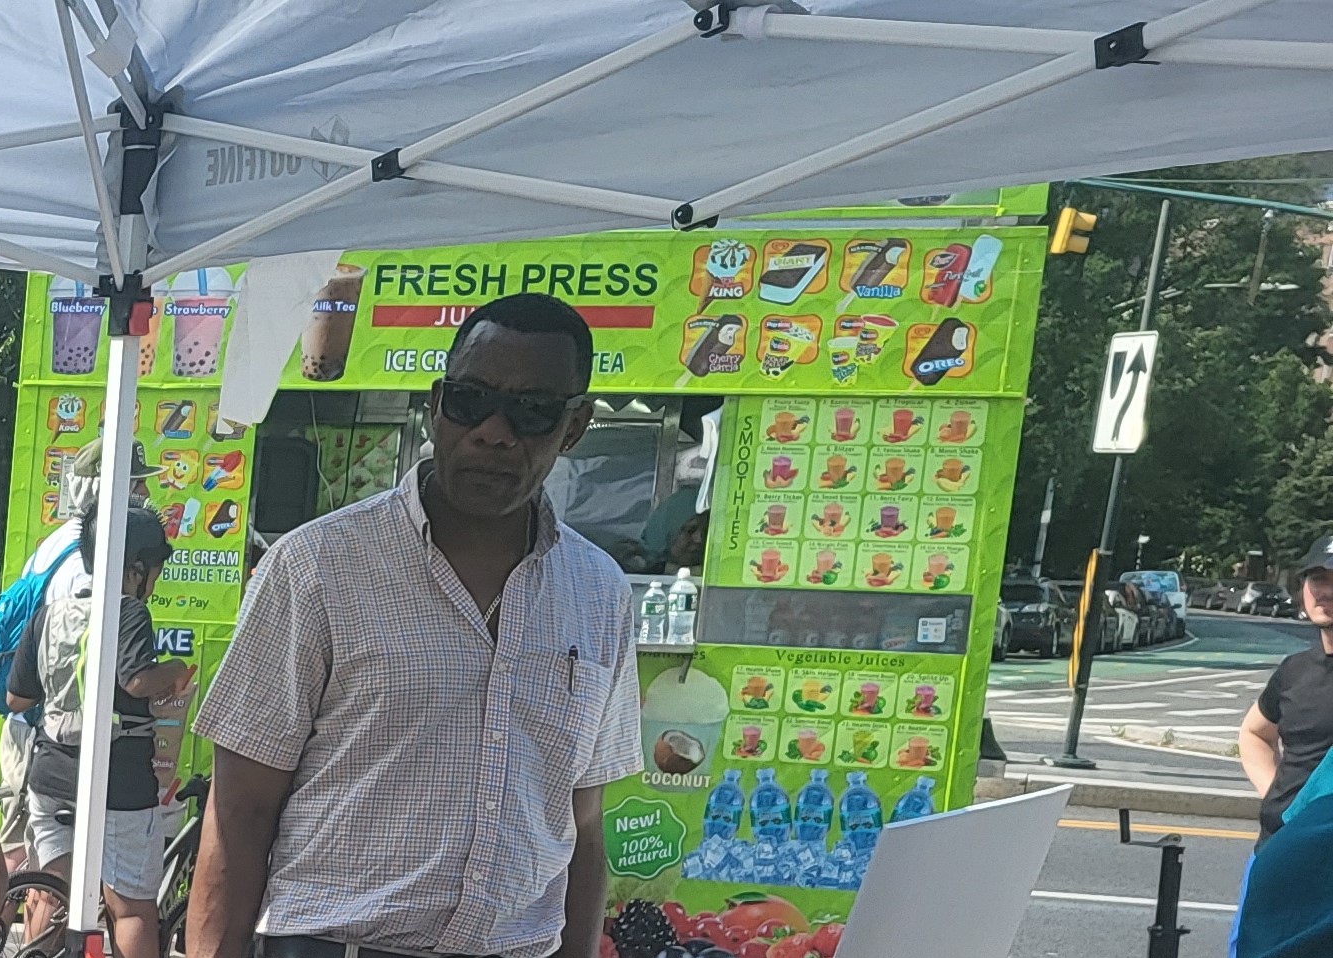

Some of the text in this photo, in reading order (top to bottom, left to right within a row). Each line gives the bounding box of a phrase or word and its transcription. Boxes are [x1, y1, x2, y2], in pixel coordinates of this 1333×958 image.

[374, 263, 659, 296] FRESH PRESS
[709, 287, 743, 297] KING
[856, 286, 902, 298] Vanilla
[51, 302, 106, 316] Blueberry
[165, 304, 231, 317] Strawberry
[335, 301, 355, 312] Tea
[385, 350, 416, 371] ICE
[708, 354, 741, 366] Cherry
[918, 358, 965, 374] OREO
[729, 415, 754, 550] SMOOTHIES
[192, 550, 239, 565] CREAM
[162, 568, 241, 583] BUBBLE TEA
[151, 594, 172, 608] Pay
[189, 596, 209, 610] Pay
[776, 650, 906, 667] Vegetable Juices
[641, 772, 713, 788] COCONUT
[616, 809, 661, 833] New!
[621, 834, 664, 855] 100%
[618, 843, 673, 868] natural
